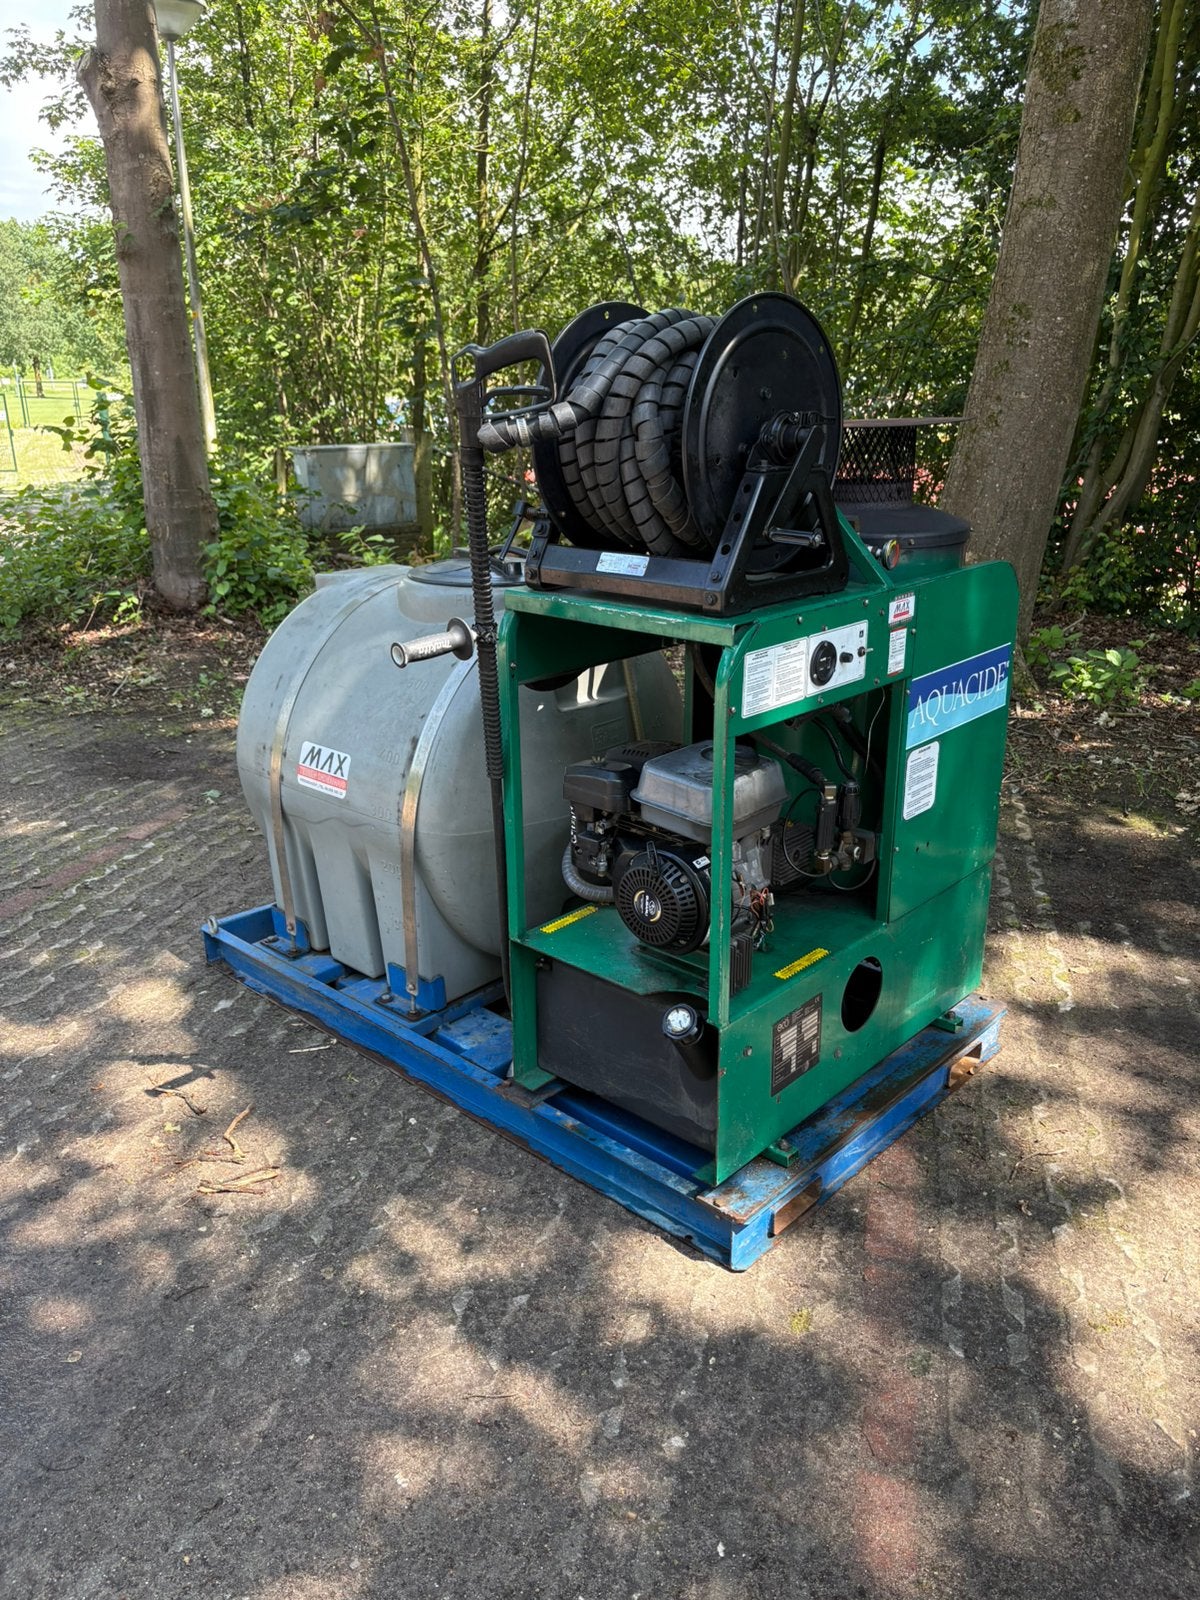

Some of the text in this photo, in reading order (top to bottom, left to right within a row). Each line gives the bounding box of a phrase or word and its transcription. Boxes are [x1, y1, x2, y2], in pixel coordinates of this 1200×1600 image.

[894, 601, 910, 613] MAX
[910, 661, 1007, 729] AQUACIDE
[302, 746, 348, 777] MAX
